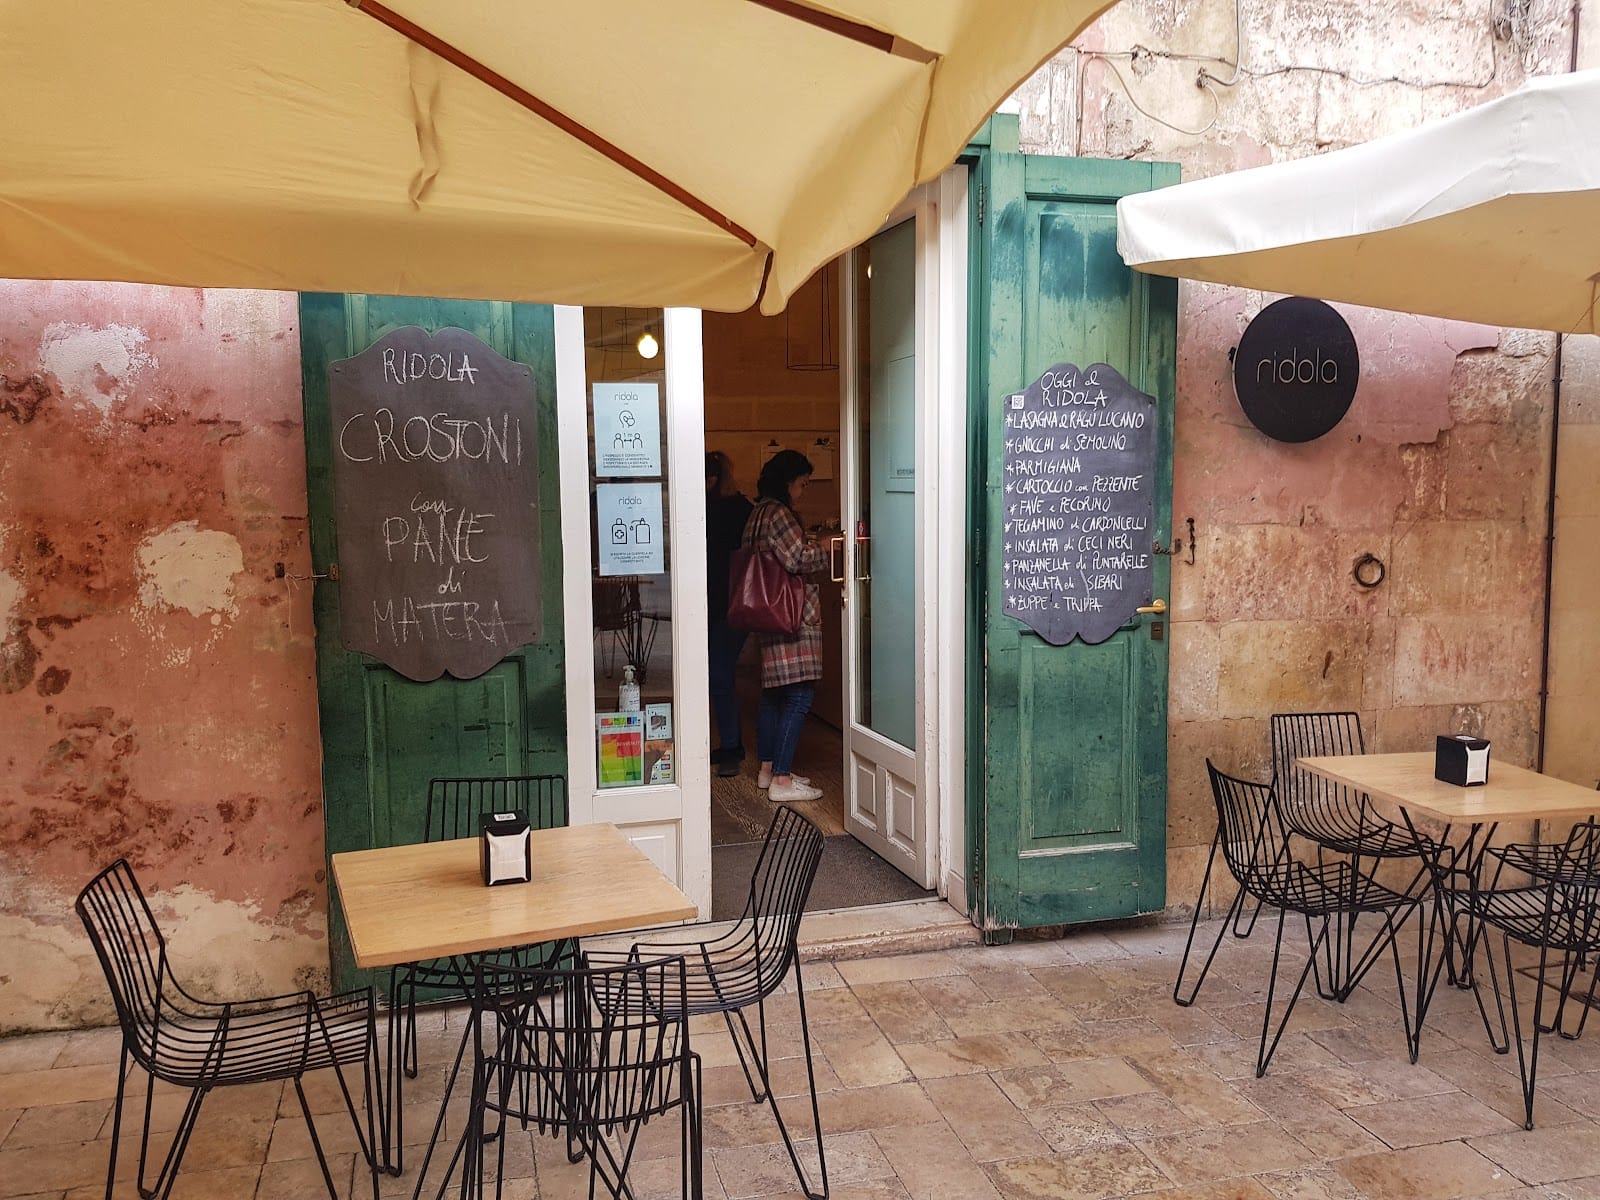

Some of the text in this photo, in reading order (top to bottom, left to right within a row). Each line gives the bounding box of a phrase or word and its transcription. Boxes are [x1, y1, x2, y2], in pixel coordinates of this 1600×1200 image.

[382, 348, 479, 384] RIDOLA
[1257, 347, 1338, 383] ridola
[1041, 372, 1076, 390] OGGI
[614, 392, 638, 400] ridola
[1041, 389, 1107, 407] RIDOLA
[1013, 411, 1058, 430] LASAGNA
[1099, 412, 1144, 429] LUCANO
[340, 408, 521, 466] CROSTONI
[1015, 432, 1126, 454] GNOCCHI di SEMOLINO
[1015, 457, 1080, 476] PARMIGIANA
[1016, 479, 1072, 494] CARTOCCIO
[1092, 475, 1143, 493] PEZZENTE
[1020, 496, 1044, 515] FAVE
[1060, 496, 1111, 513] PECORINO
[1013, 516, 1147, 535] TEGAMINO di CARDONCELLI
[383, 507, 496, 566] PANE
[1015, 533, 1133, 553] INSALATA di CECI NERI
[1013, 551, 1148, 575] PANZANELLA di PUNTARELLE
[438, 566, 466, 594] di
[1014, 576, 1063, 592] INSALATA
[1087, 574, 1122, 591] SIBARI
[1018, 596, 1048, 611] ZUPPE
[374, 597, 509, 647] MATERA
